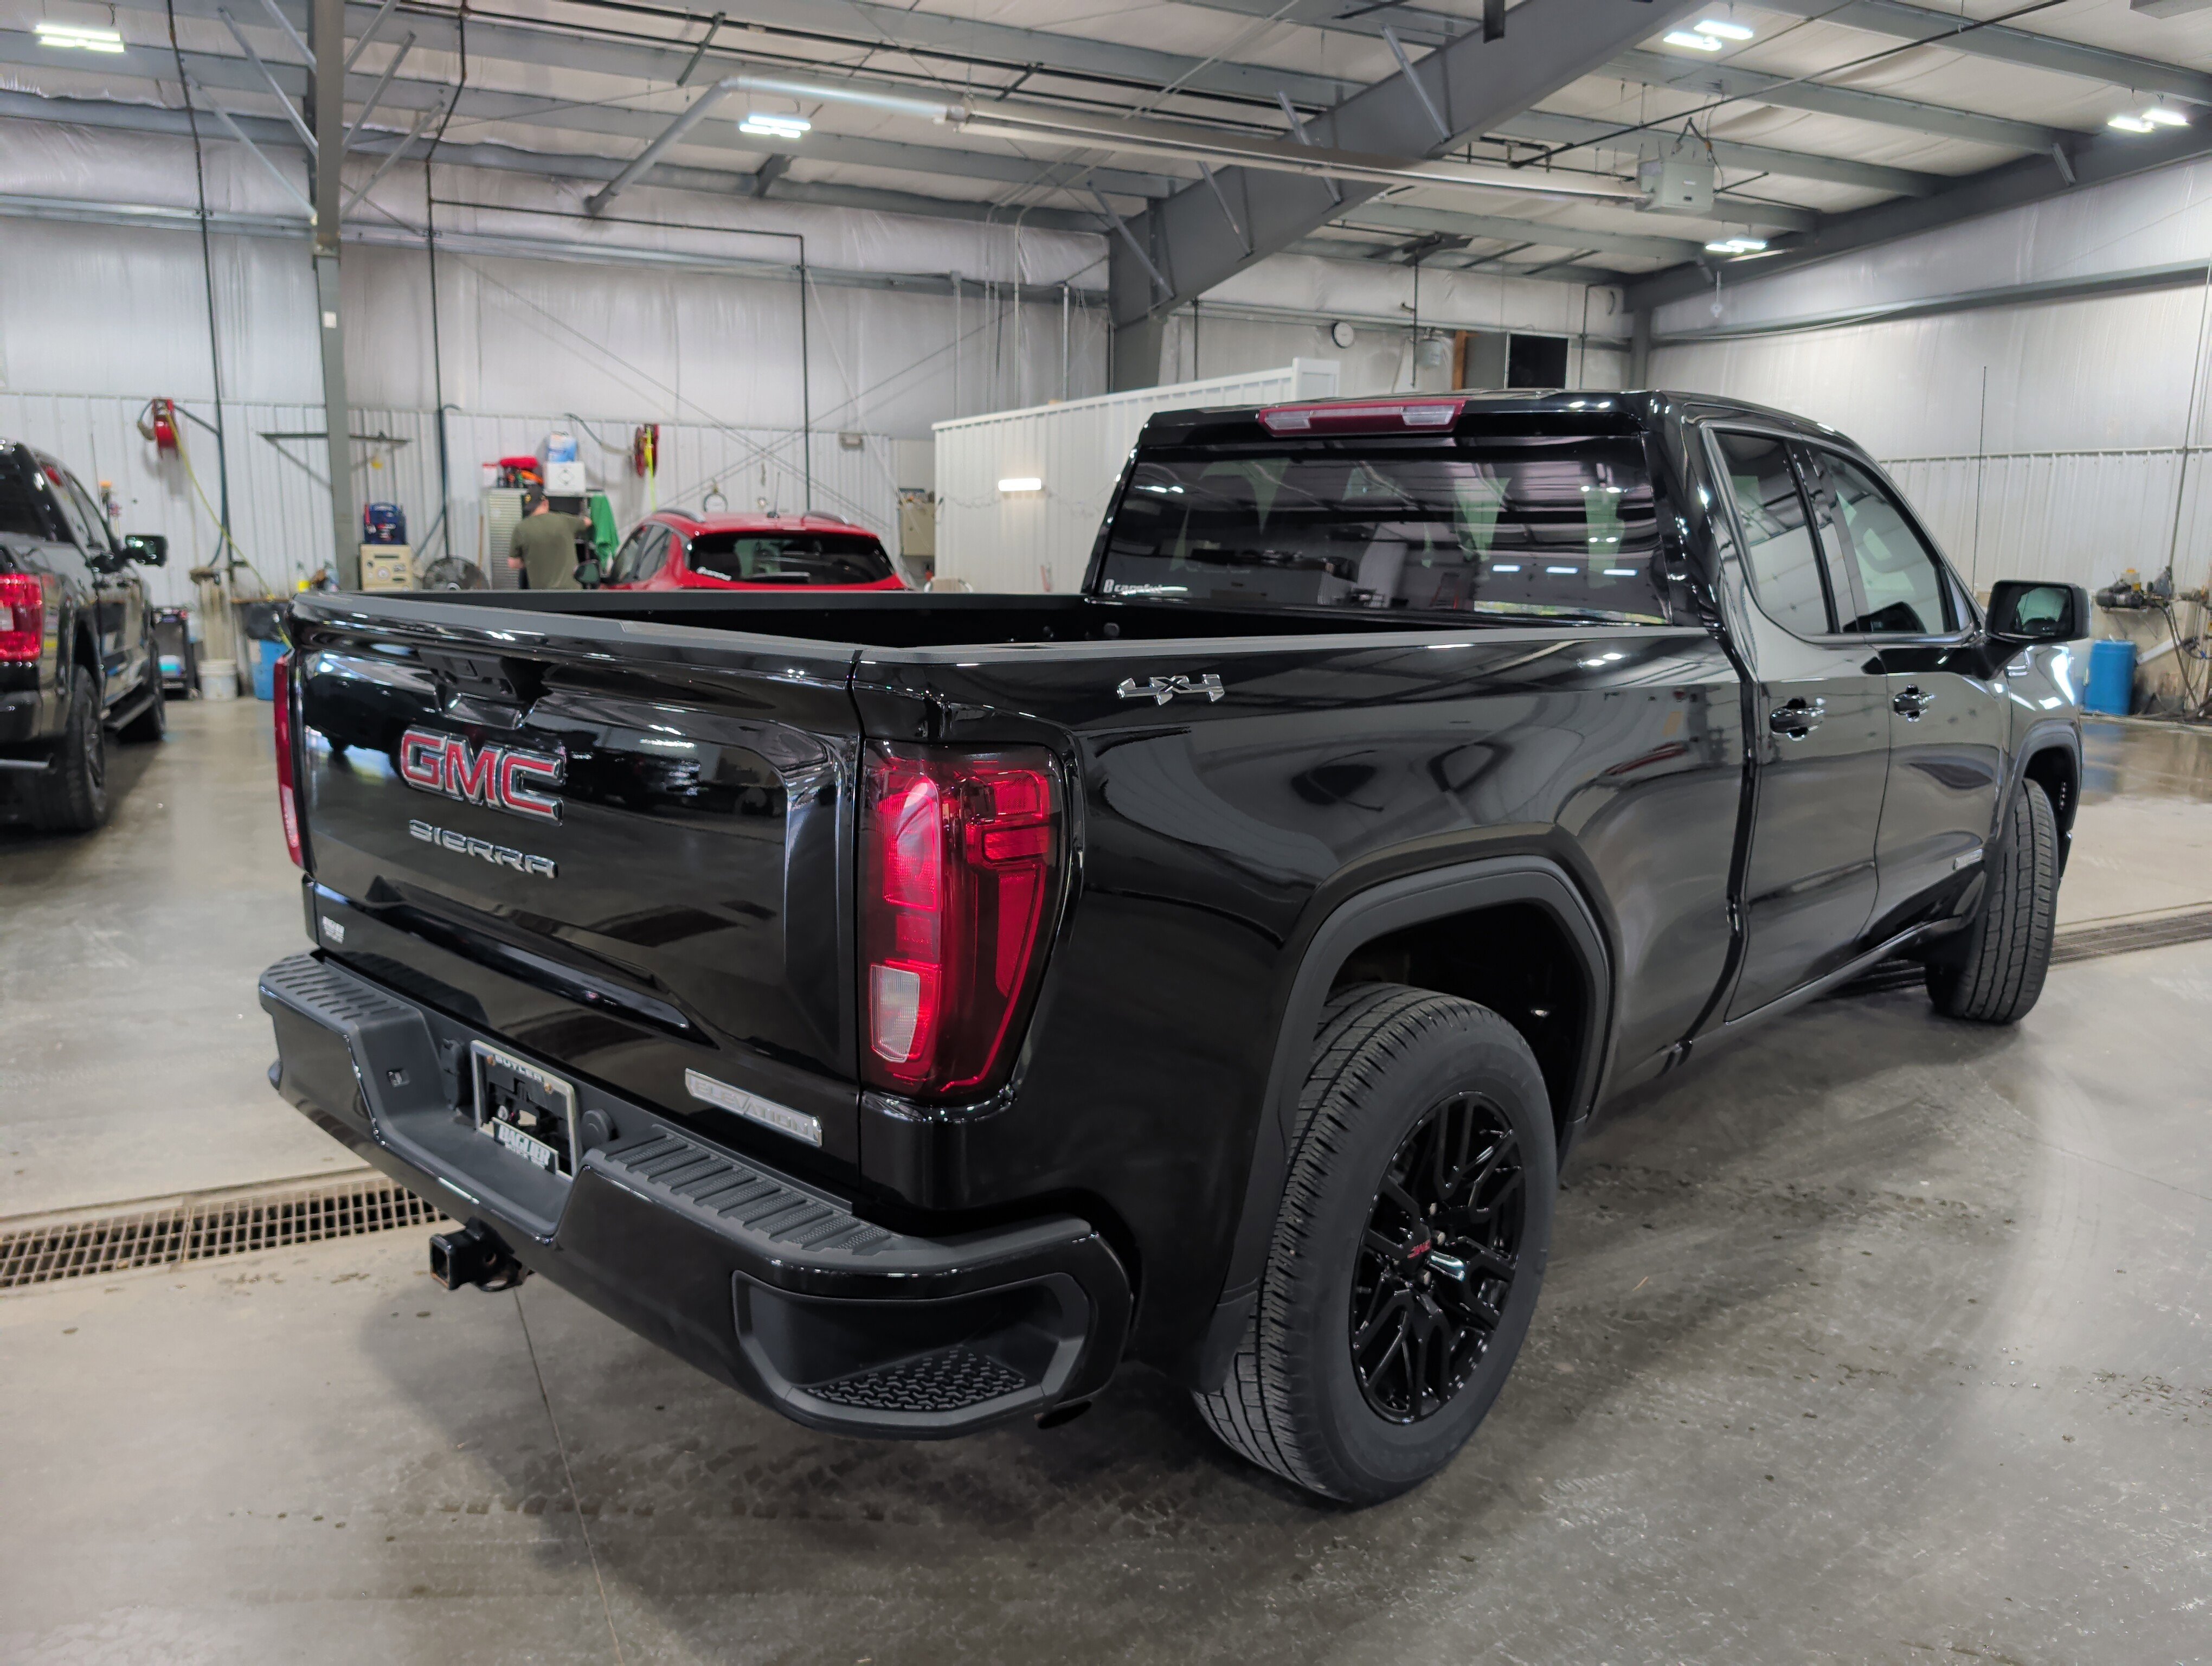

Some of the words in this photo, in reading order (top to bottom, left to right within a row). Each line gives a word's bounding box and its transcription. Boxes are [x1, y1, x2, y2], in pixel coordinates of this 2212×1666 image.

[401, 726, 567, 826] GMC
[409, 819, 558, 879] SIERRA
[494, 1054, 543, 1083] BUTLER
[695, 1078, 808, 1136] ELEVATION
